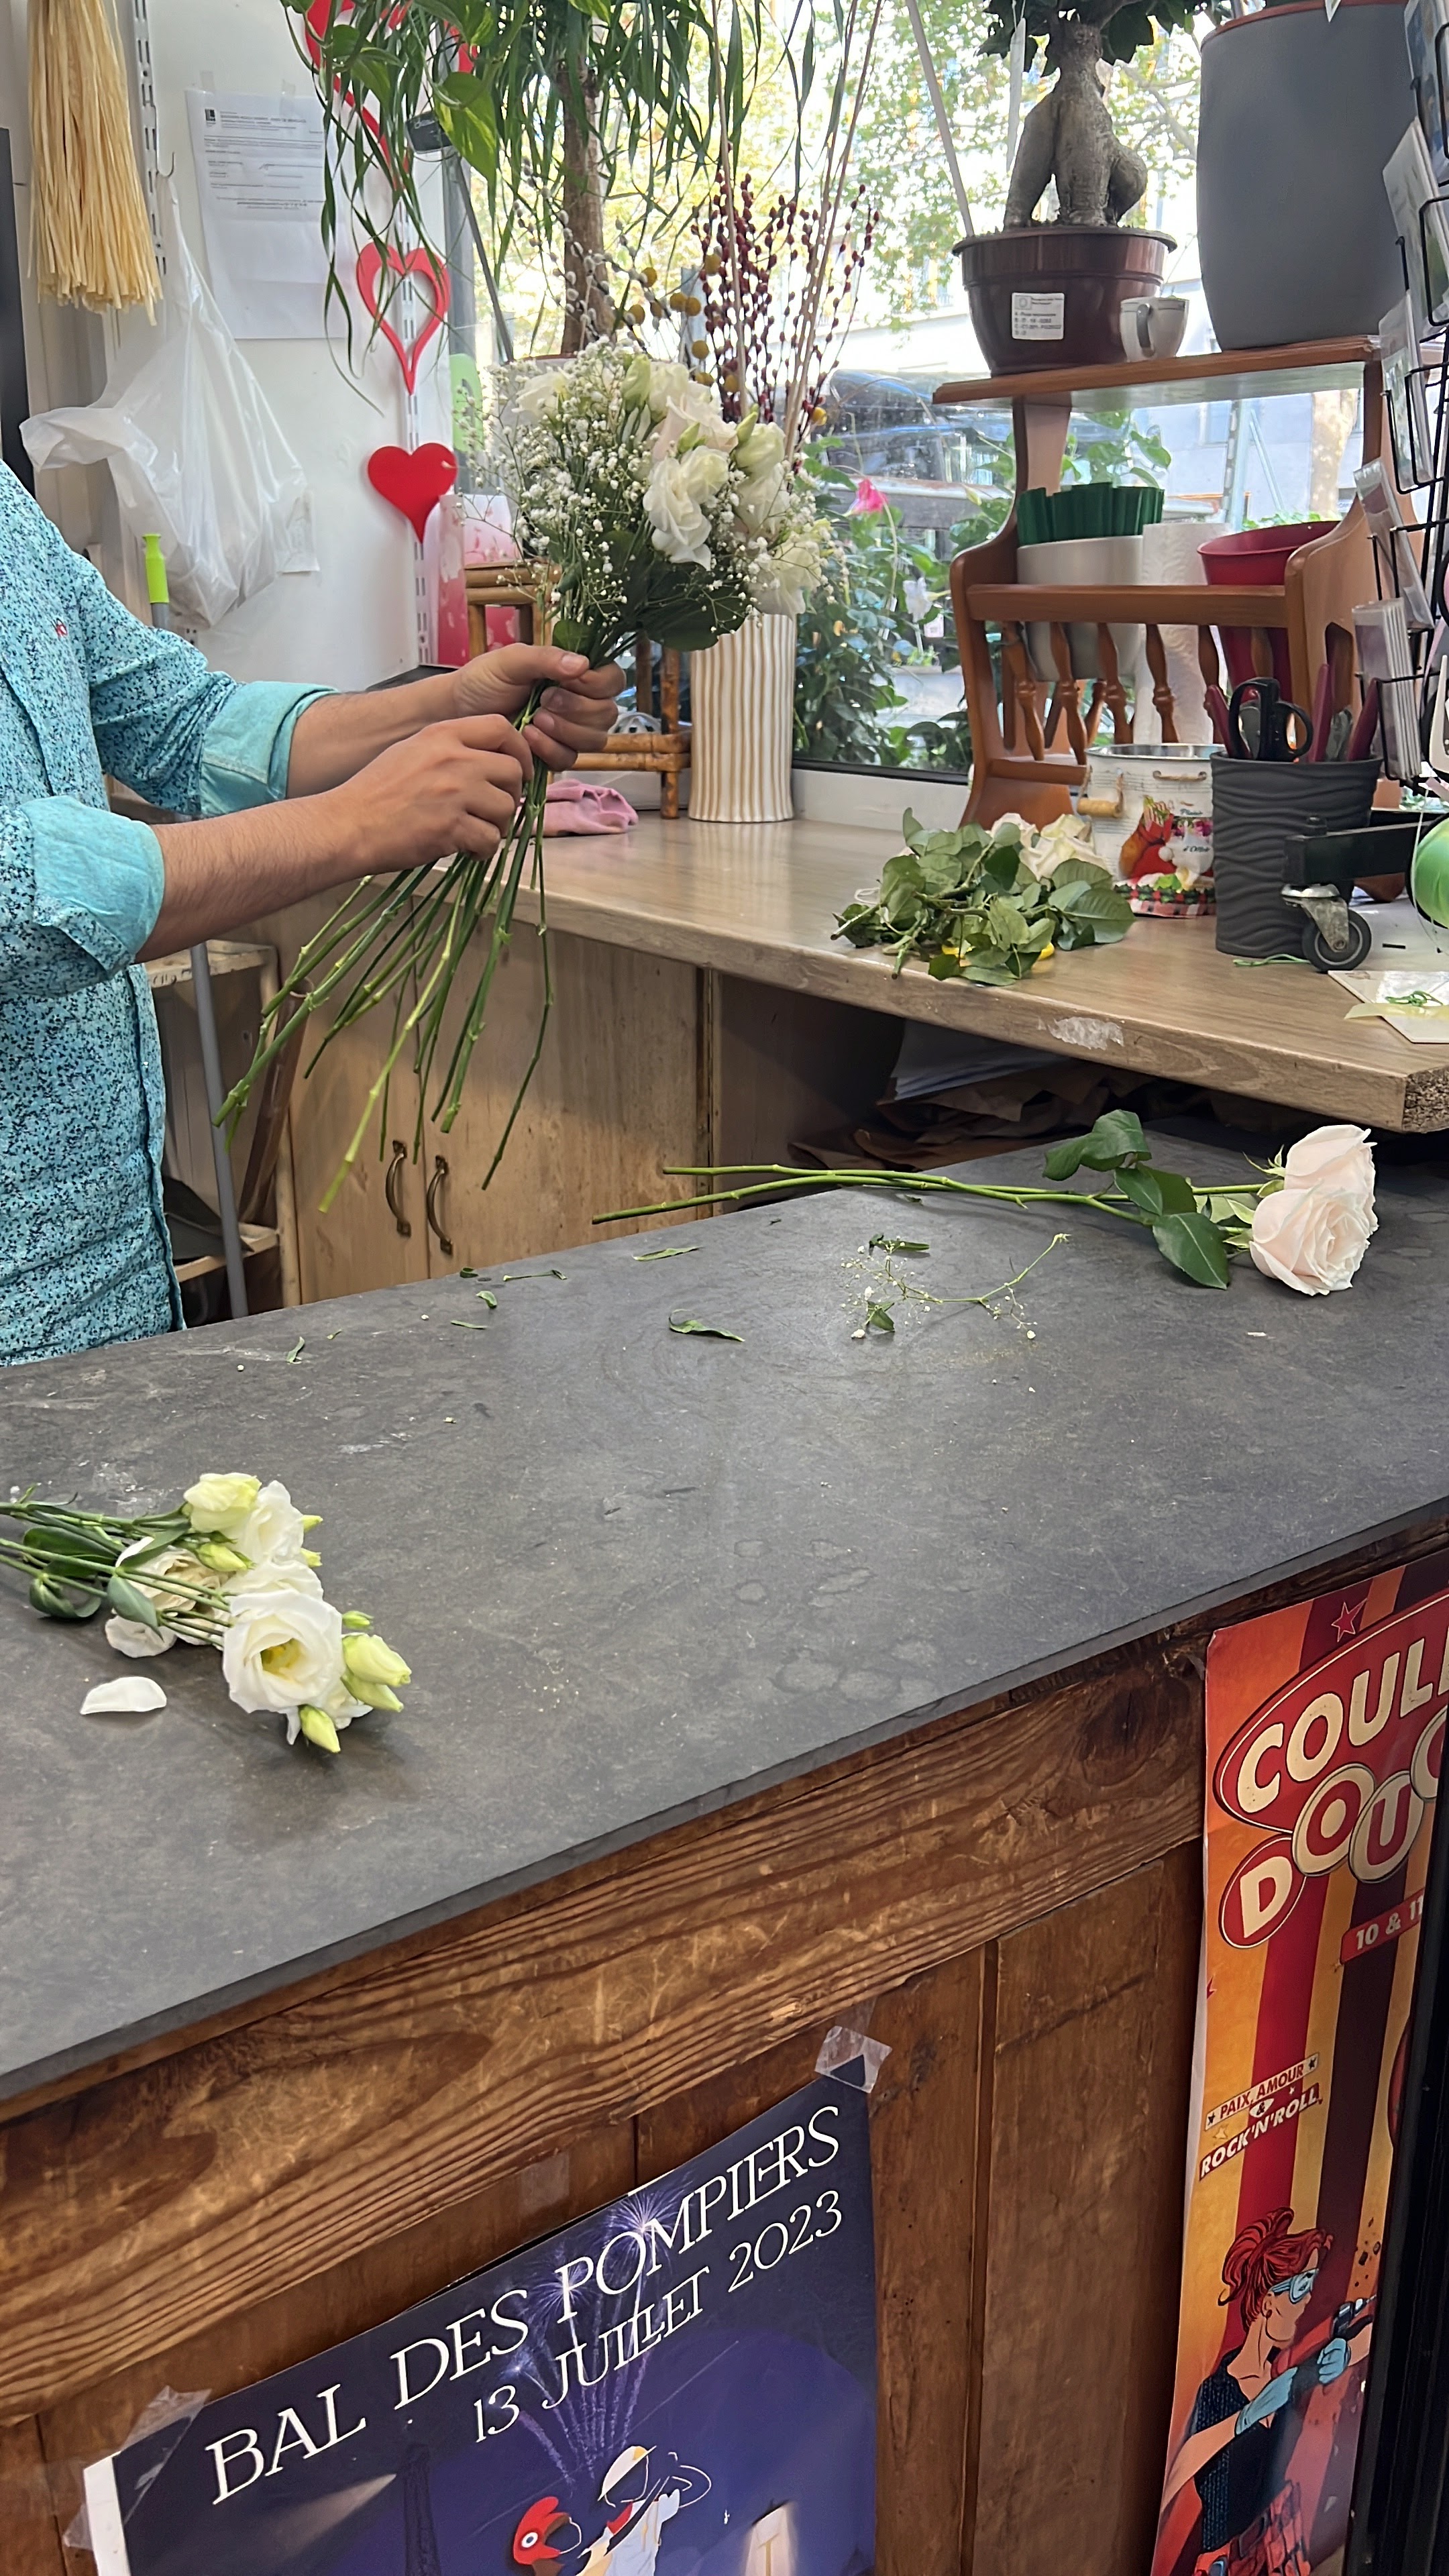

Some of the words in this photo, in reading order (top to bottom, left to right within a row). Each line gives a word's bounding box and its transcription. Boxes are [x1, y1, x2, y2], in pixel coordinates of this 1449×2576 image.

[1356, 1923, 1379, 1950] 10
[1385, 1913, 1401, 1935] &
[1256, 2063, 1304, 2099] AMOUR
[205, 2383, 366, 2506] BAL
[389, 2289, 529, 2410] DES
[555, 2106, 841, 2324] POMPIERS
[473, 2385, 521, 2443] 13
[541, 2266, 710, 2410] JUILLET
[728, 2190, 843, 2293] 2023
